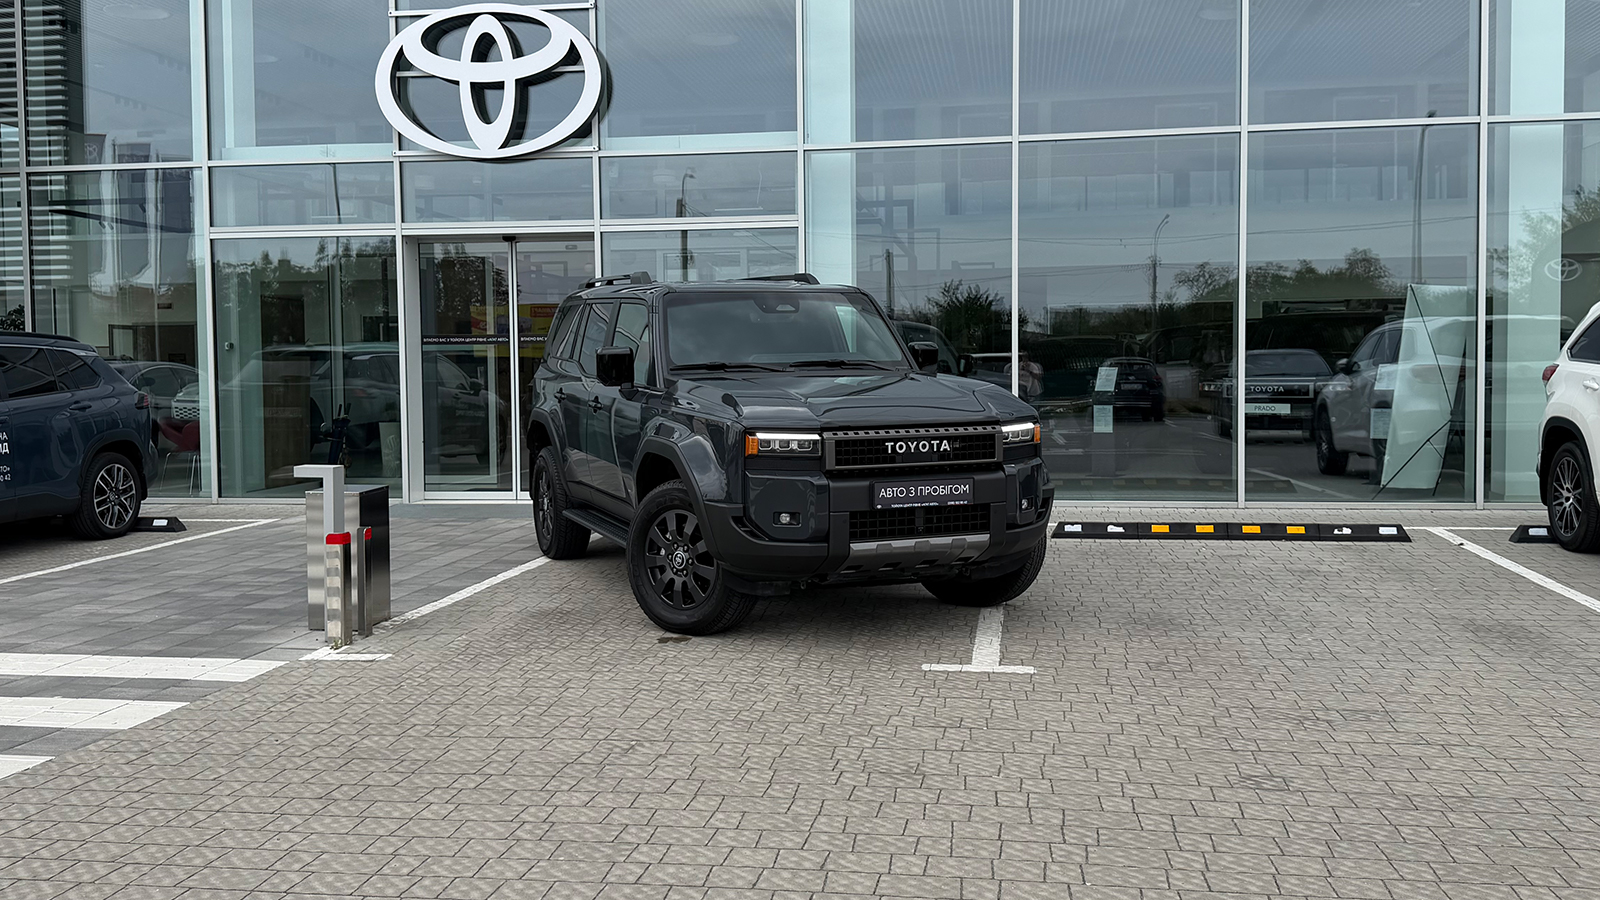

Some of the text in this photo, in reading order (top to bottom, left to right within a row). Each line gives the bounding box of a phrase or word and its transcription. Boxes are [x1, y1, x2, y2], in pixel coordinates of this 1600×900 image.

[885, 440, 950, 453] TOYOTA
[879, 487, 906, 498] АВТО
[917, 484, 969, 496] ПРОБІГОМ
